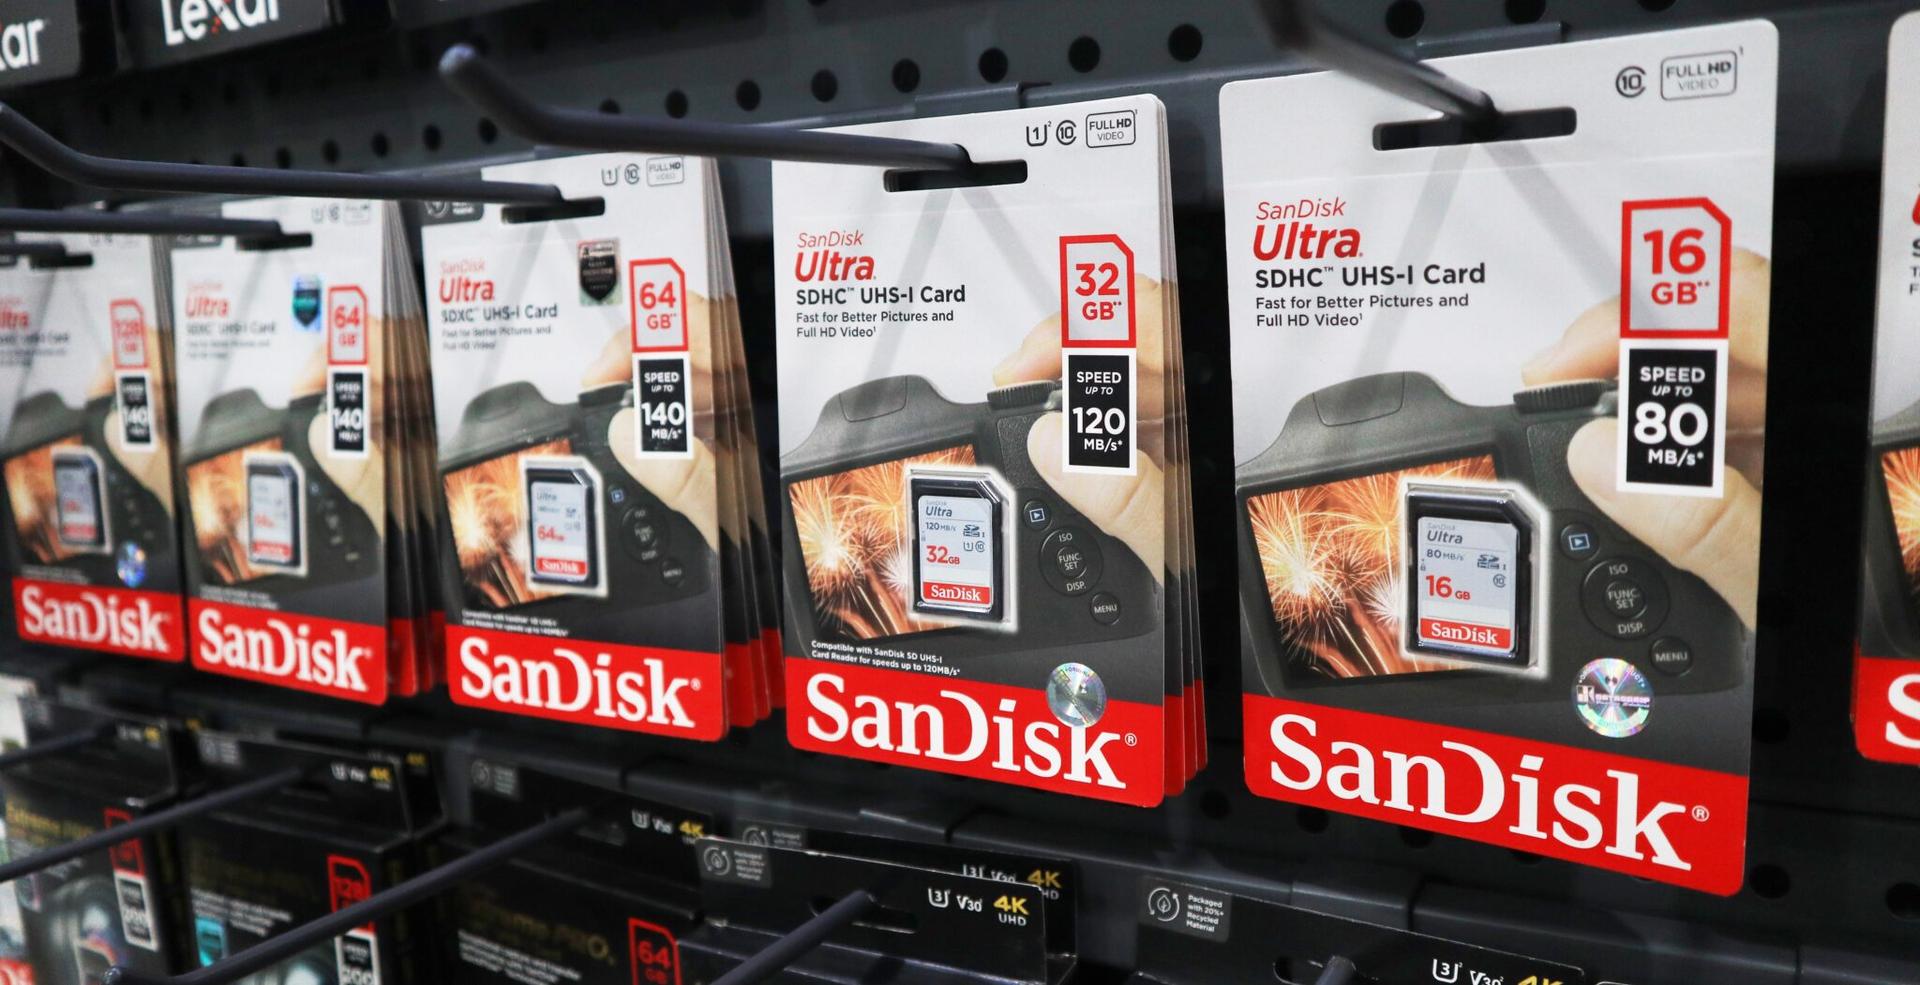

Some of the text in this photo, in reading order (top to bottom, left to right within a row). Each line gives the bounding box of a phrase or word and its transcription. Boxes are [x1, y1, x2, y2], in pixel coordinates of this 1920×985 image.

[1678, 78, 1720, 91] VIDEO
[1097, 131, 1125, 141] VIDEO
[1256, 197, 1347, 221] SanDisk
[797, 229, 864, 248] SanDisk
[1643, 228, 1706, 275] 16
[1074, 262, 1120, 297] 32
[1342, 264, 1414, 287] UHS-I
[1423, 262, 1486, 285] Card
[639, 280, 676, 310] 64
[860, 286, 914, 304] UHS-I
[920, 284, 966, 303] Card
[1255, 293, 1470, 310] Fast for Better Pictures and
[333, 306, 360, 330] 64
[524, 303, 558, 319] Card
[796, 310, 954, 323] Fast for Better Pictures and
[1256, 313, 1283, 327] Full
[1287, 313, 1310, 327] HD
[796, 327, 817, 338] Full
[820, 327, 837, 338] HD
[643, 371, 680, 383] SPEED
[1076, 371, 1122, 384] SPEED
[1639, 366, 1706, 383] SPEED
[651, 384, 674, 393] UP TO
[1085, 386, 1114, 395] UP TO
[1651, 386, 1693, 397] UP TO
[331, 406, 363, 431] 140
[641, 401, 685, 427] 140
[1072, 406, 1126, 436] 120
[1633, 401, 1709, 447] 80
[925, 506, 953, 518] Ultra
[925, 522, 940, 531] 120
[1058, 532, 1073, 543] ISO
[1426, 530, 1463, 545] Ultra
[1426, 549, 1442, 559] 80
[542, 560, 579, 574] SanDisk
[1064, 561, 1078, 571] SET
[1608, 564, 1629, 576] ISO
[930, 585, 982, 602] SanDisk
[1425, 574, 1471, 601] 16 GB
[1093, 604, 1118, 615] MENU
[1616, 599, 1635, 610] SET
[1430, 622, 1499, 646] SanDisk
[811, 640, 943, 664] Compatible with SanDisk SD UHS-I
[1655, 652, 1688, 663] MENU
[811, 650, 830, 660] Card
[830, 652, 858, 663] Reader
[859, 655, 871, 665] for
[872, 657, 900, 670] speeds
[901, 662, 912, 672] up
[912, 662, 922, 672] to
[1027, 869, 1062, 889] 4K
[993, 895, 1030, 916] 4K
[1187, 893, 1223, 909] Packaged
[1187, 903, 1203, 912] with
[998, 912, 1027, 927] UHD
[1186, 911, 1219, 926] Recycled
[1186, 919, 1215, 933] Material
[638, 940, 672, 970] 64
